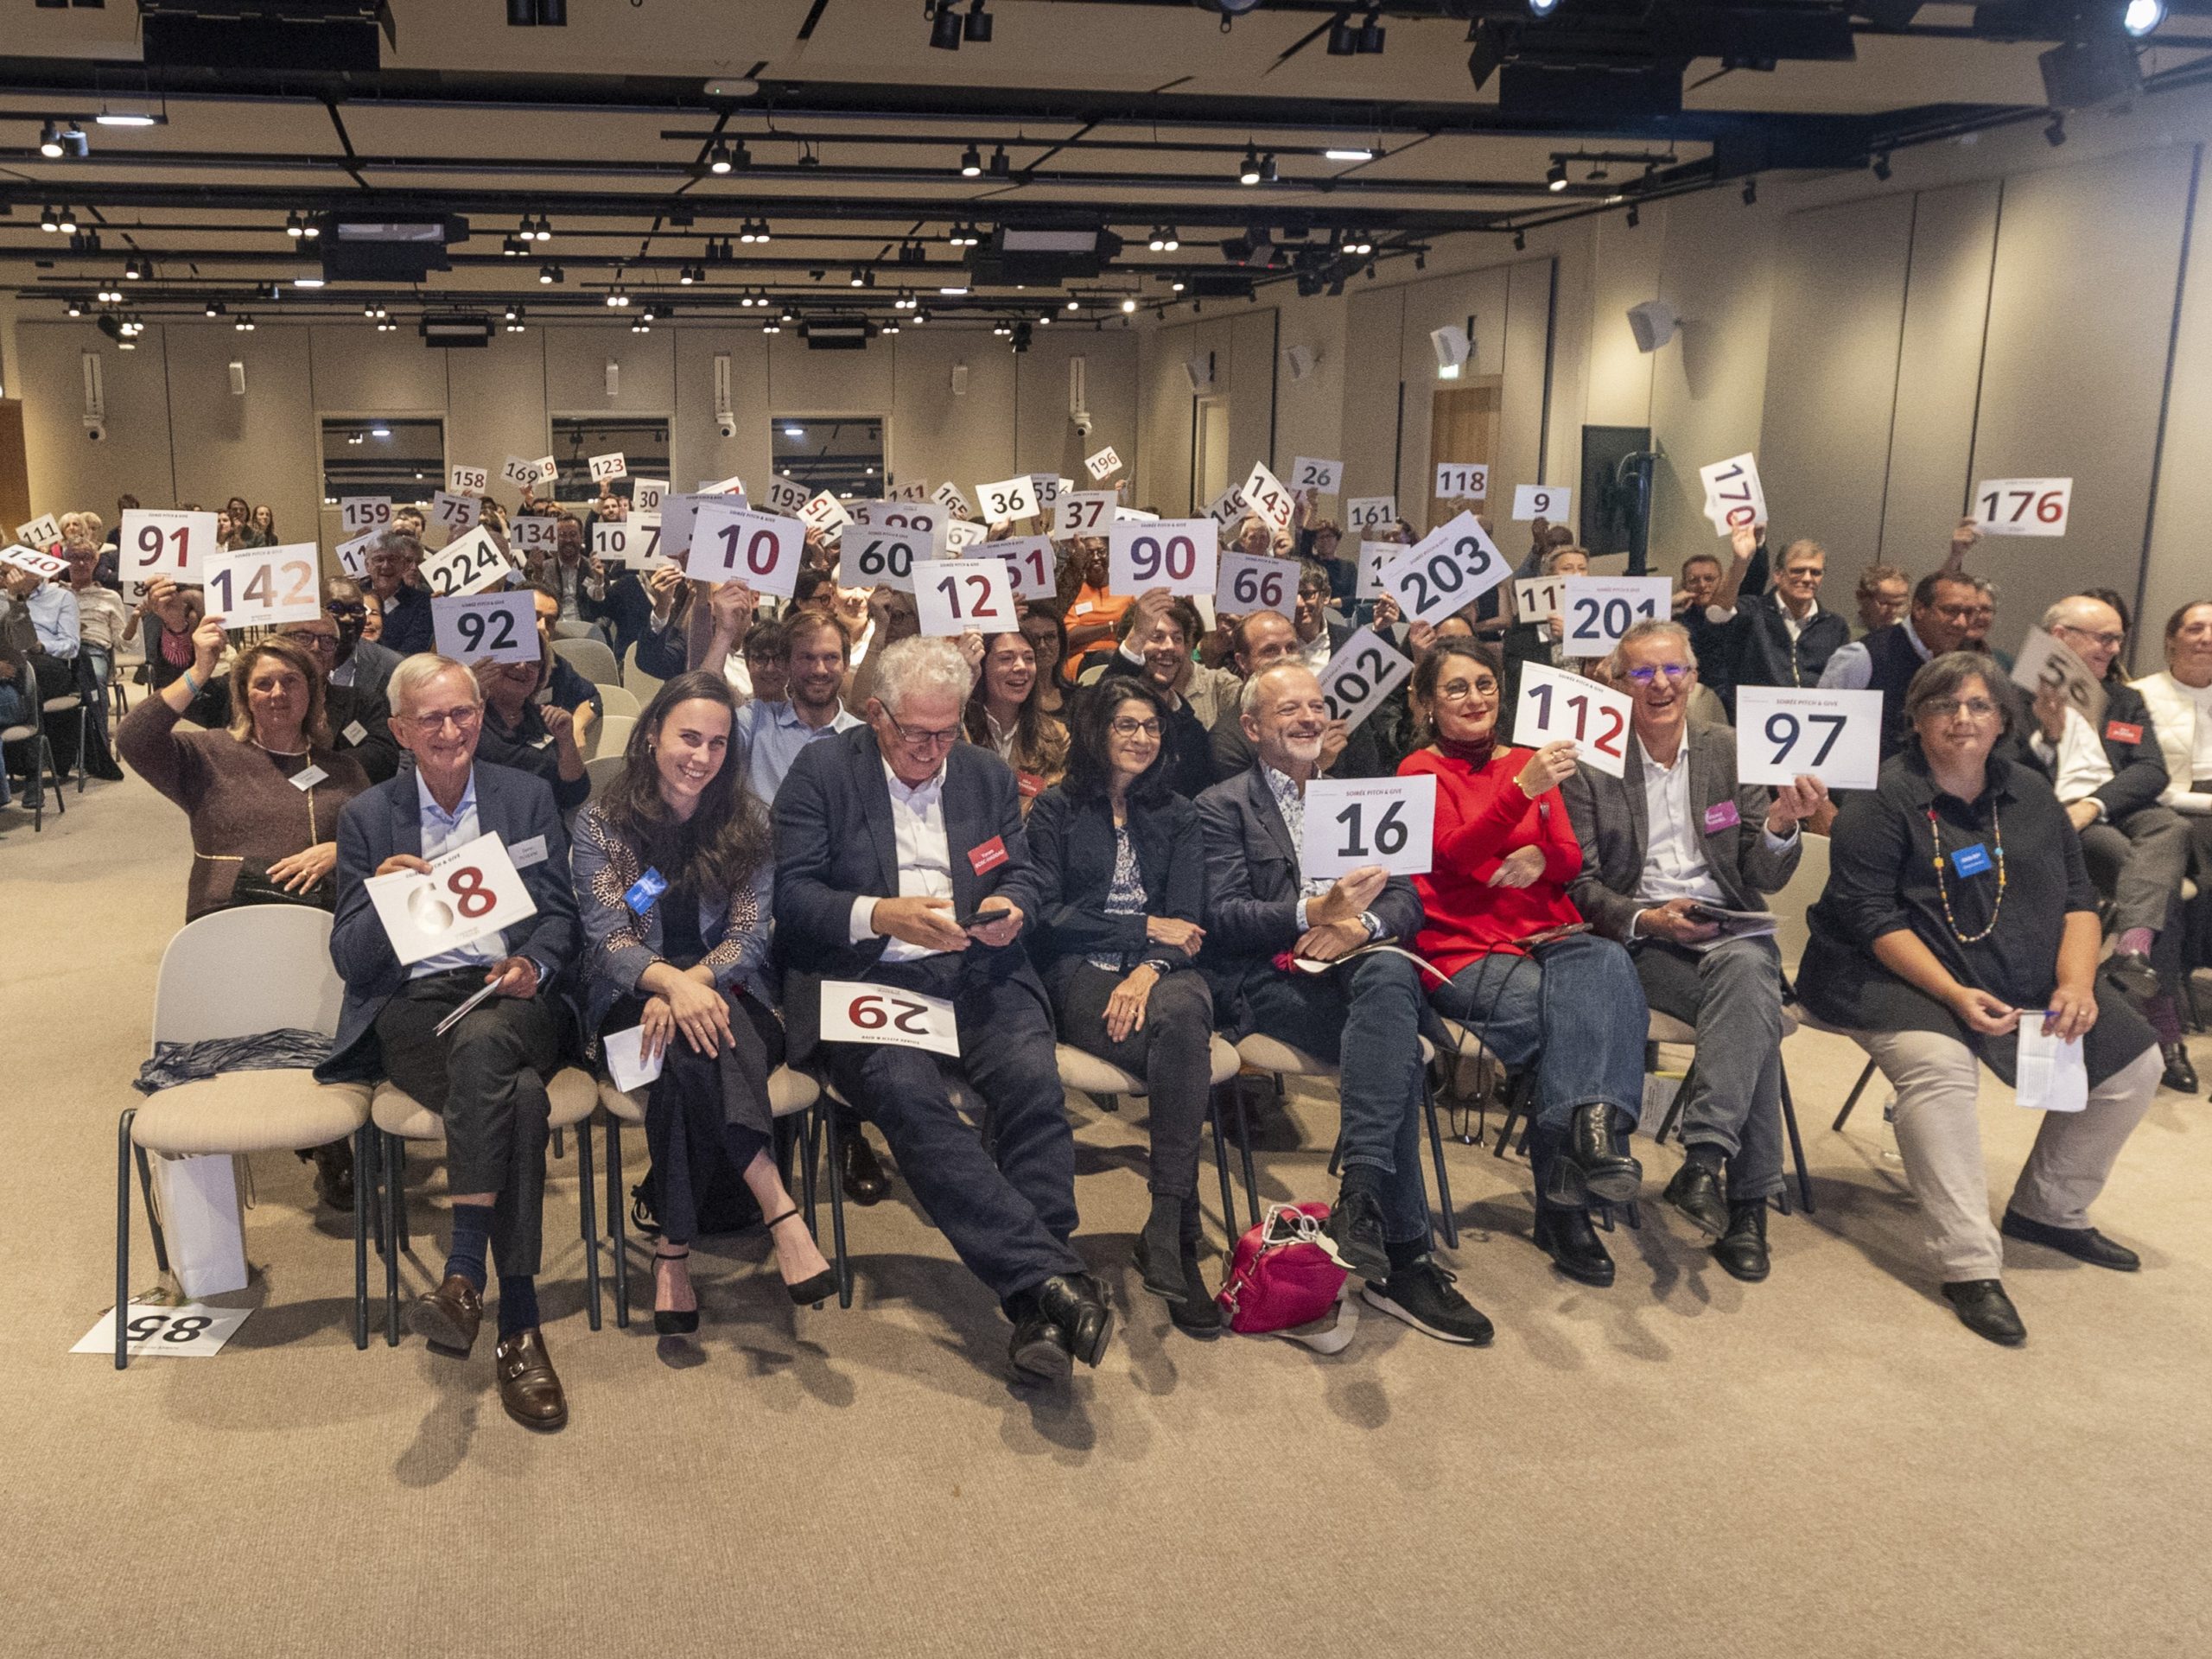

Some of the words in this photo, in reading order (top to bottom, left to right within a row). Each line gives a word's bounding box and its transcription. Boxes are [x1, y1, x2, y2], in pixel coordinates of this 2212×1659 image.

[505, 462, 537, 484] 169
[593, 458, 624, 476] 123
[1090, 452, 1117, 474] 196
[1302, 466, 1331, 486] 26
[454, 471, 485, 488] 158
[1440, 471, 1484, 491] 118
[1714, 463, 1756, 526] 170
[442, 500, 470, 524] 75
[640, 491, 658, 508] 30
[771, 483, 806, 512] 193
[938, 487, 968, 519] 165
[991, 489, 1025, 514] 36
[1211, 490, 1246, 525] 146
[1252, 476, 1290, 526] 143
[1534, 493, 1550, 512] 9
[1982, 491, 2063, 524] 176
[346, 504, 390, 524] 159
[1065, 501, 1104, 529] 37
[1351, 505, 1393, 526] 161
[23, 521, 58, 543] 111
[138, 525, 189, 567] 91
[512, 524, 556, 543] 134
[8, 549, 60, 571] 140
[717, 524, 780, 575] 10
[859, 540, 913, 578] 60
[1130, 536, 1196, 581] 90
[433, 540, 499, 596] 224
[1401, 536, 1491, 615] 203
[210, 561, 315, 612] 142
[937, 575, 998, 619] 12
[1234, 568, 1283, 607] 66
[458, 609, 518, 652] 92
[1528, 683, 1624, 759] 112
[1765, 712, 1847, 766] 97
[1335, 800, 1408, 857] 16
[407, 866, 497, 935] 68
[849, 995, 930, 1035] 29
[127, 1315, 213, 1343] 85
